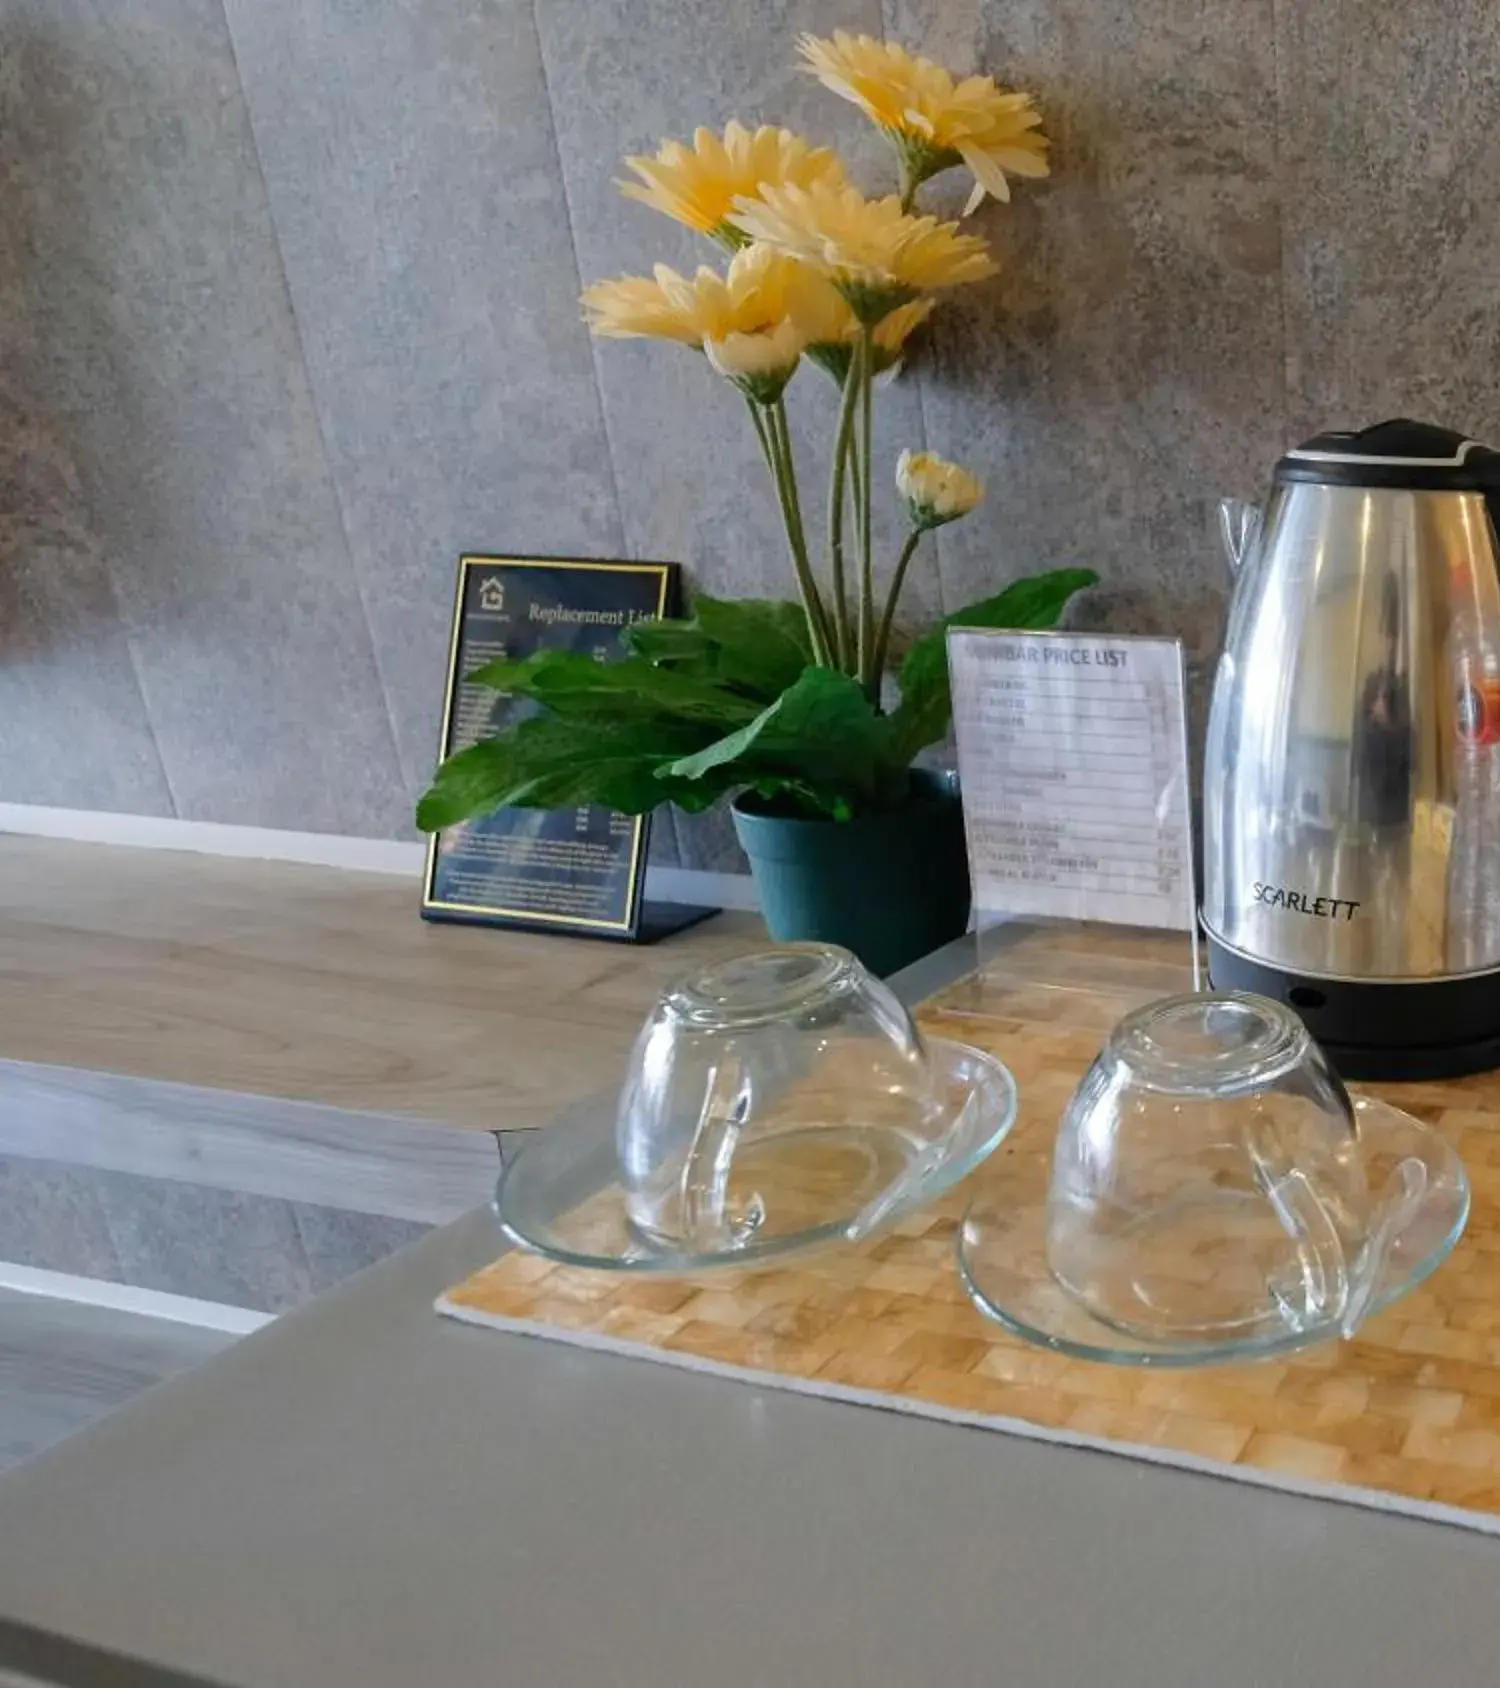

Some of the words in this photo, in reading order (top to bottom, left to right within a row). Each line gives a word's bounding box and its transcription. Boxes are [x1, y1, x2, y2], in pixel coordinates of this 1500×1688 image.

[528, 602, 624, 625] Replacement
[1044, 646, 1091, 666] PRICE
[1095, 648, 1129, 668] LIST
[1252, 881, 1361, 921] SCARLETT
